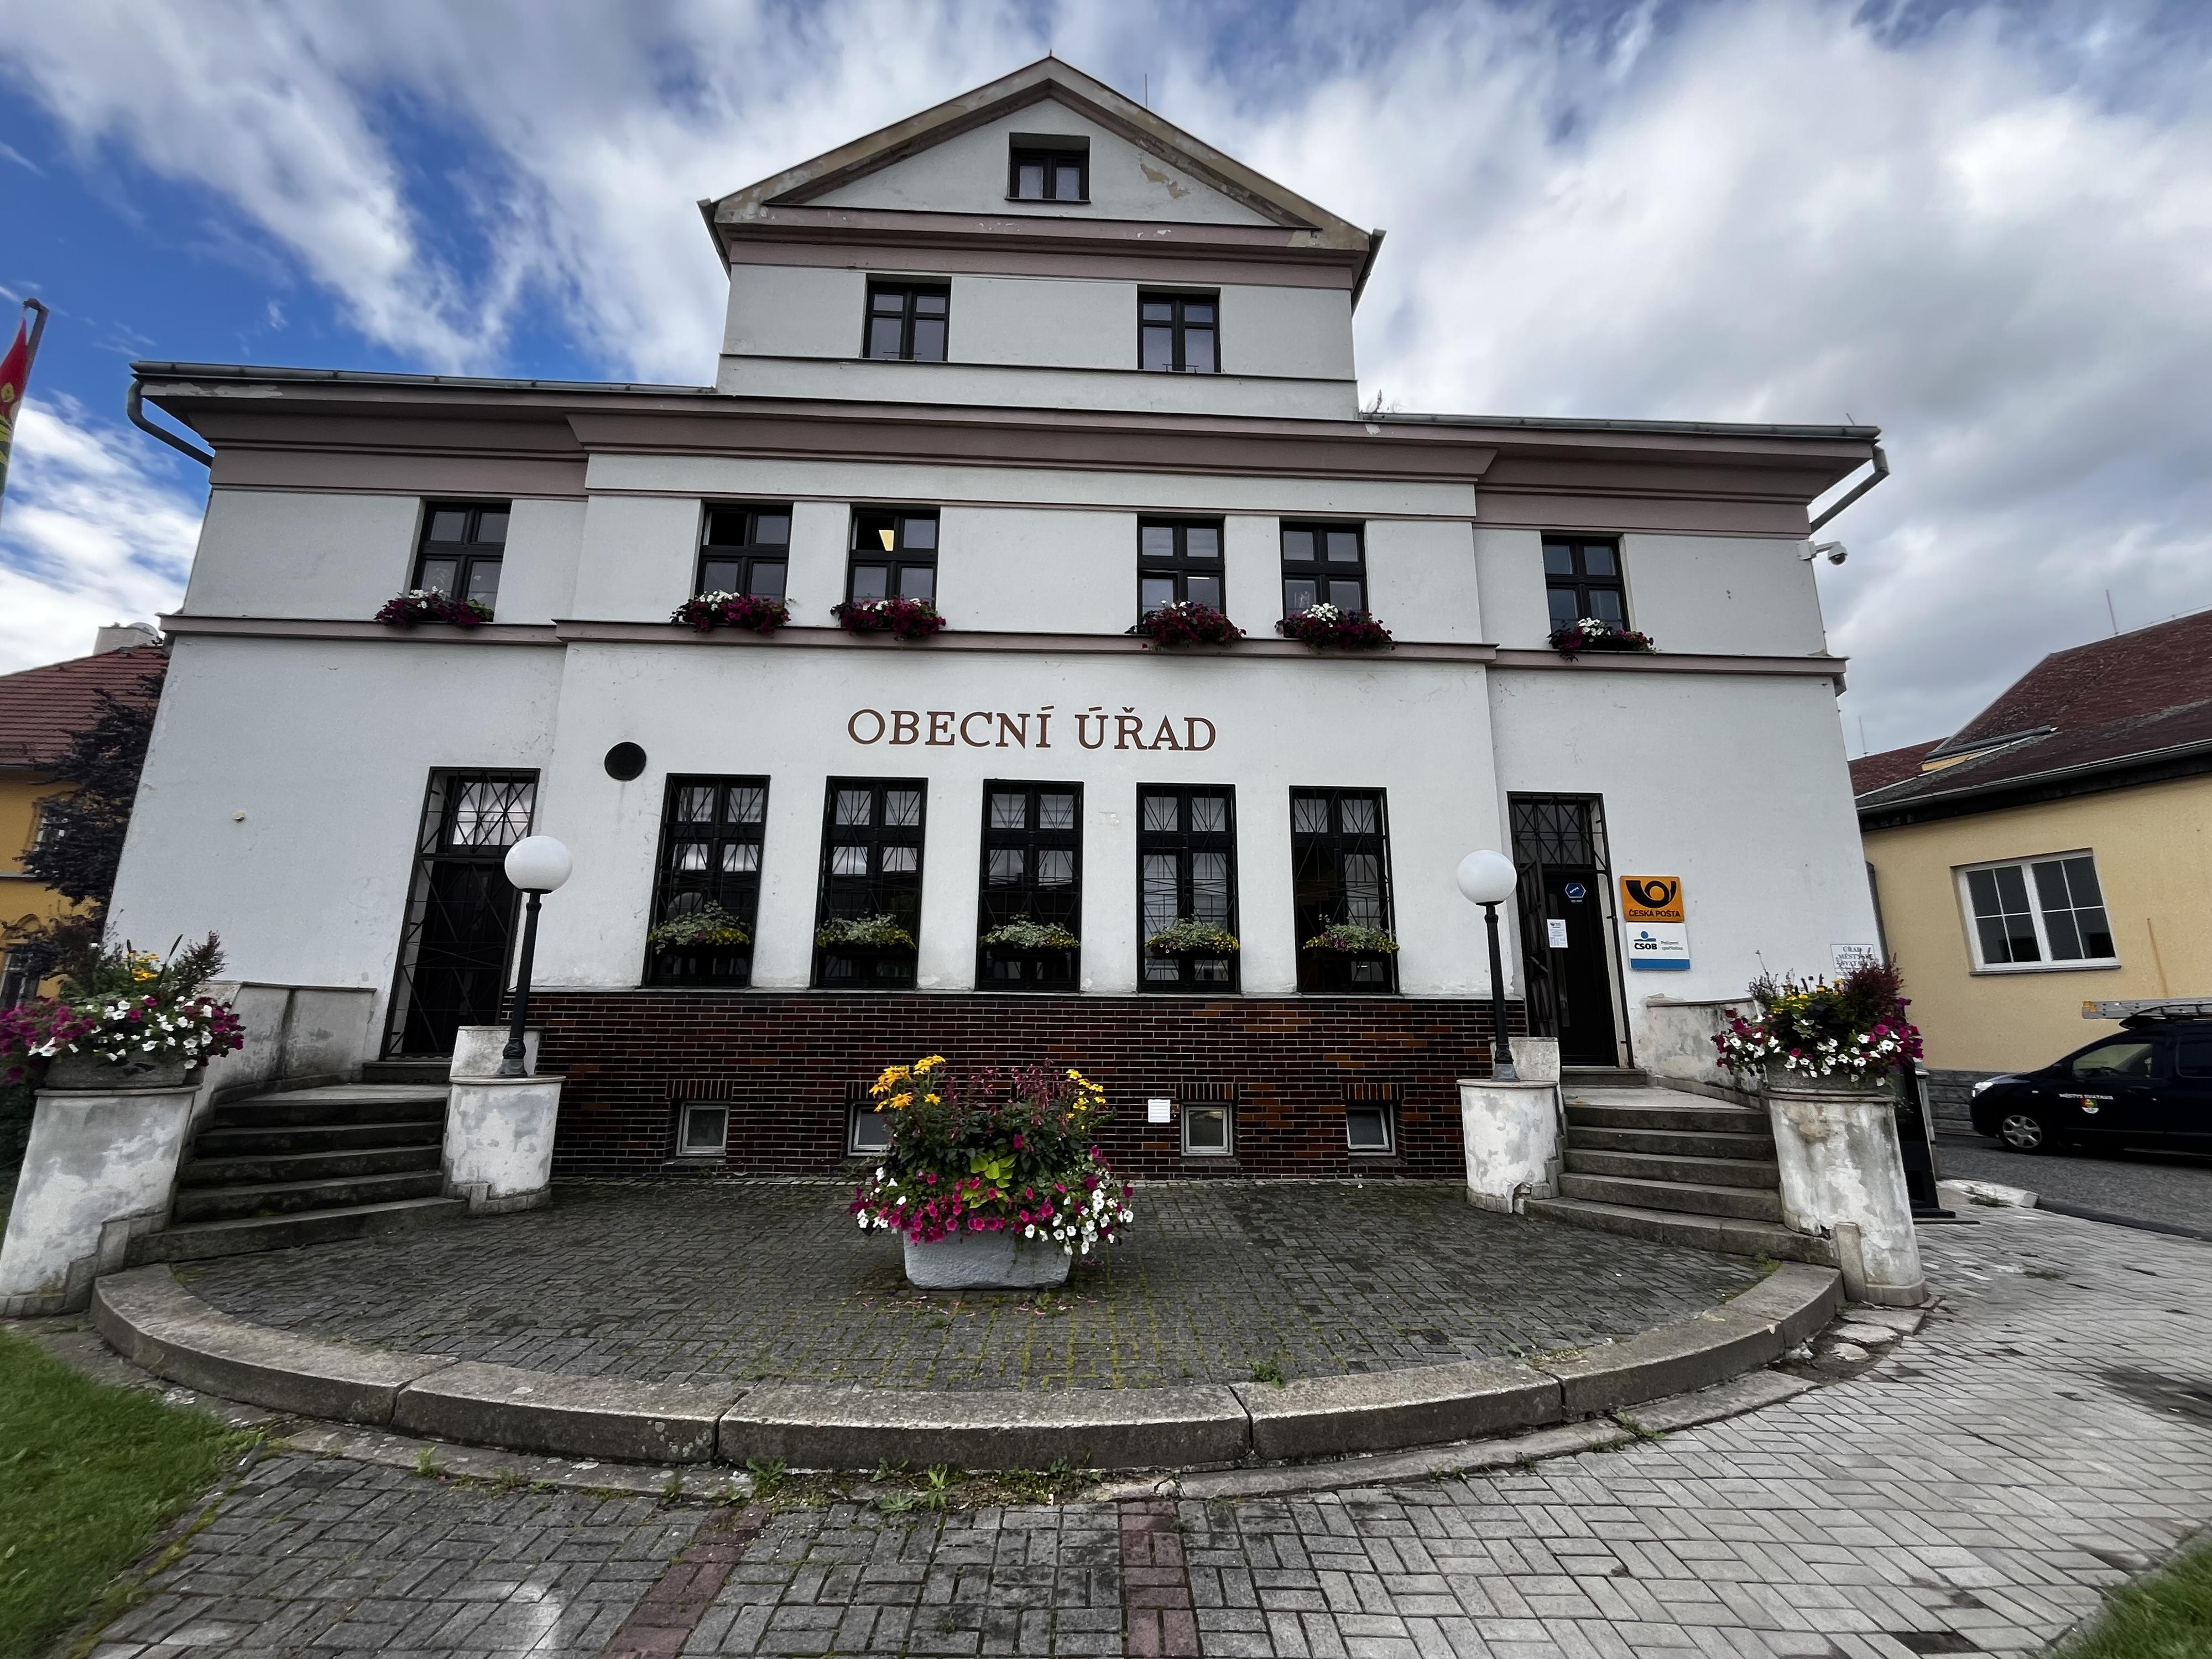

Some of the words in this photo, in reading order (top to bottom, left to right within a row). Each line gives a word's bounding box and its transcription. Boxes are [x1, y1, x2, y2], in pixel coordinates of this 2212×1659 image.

[847, 705, 1055, 749] OBECNÍ
[1074, 706, 1217, 752] ÚŘAD
[1629, 909, 1654, 917] ČESKÁ
[1656, 909, 1681, 917] POŠTA
